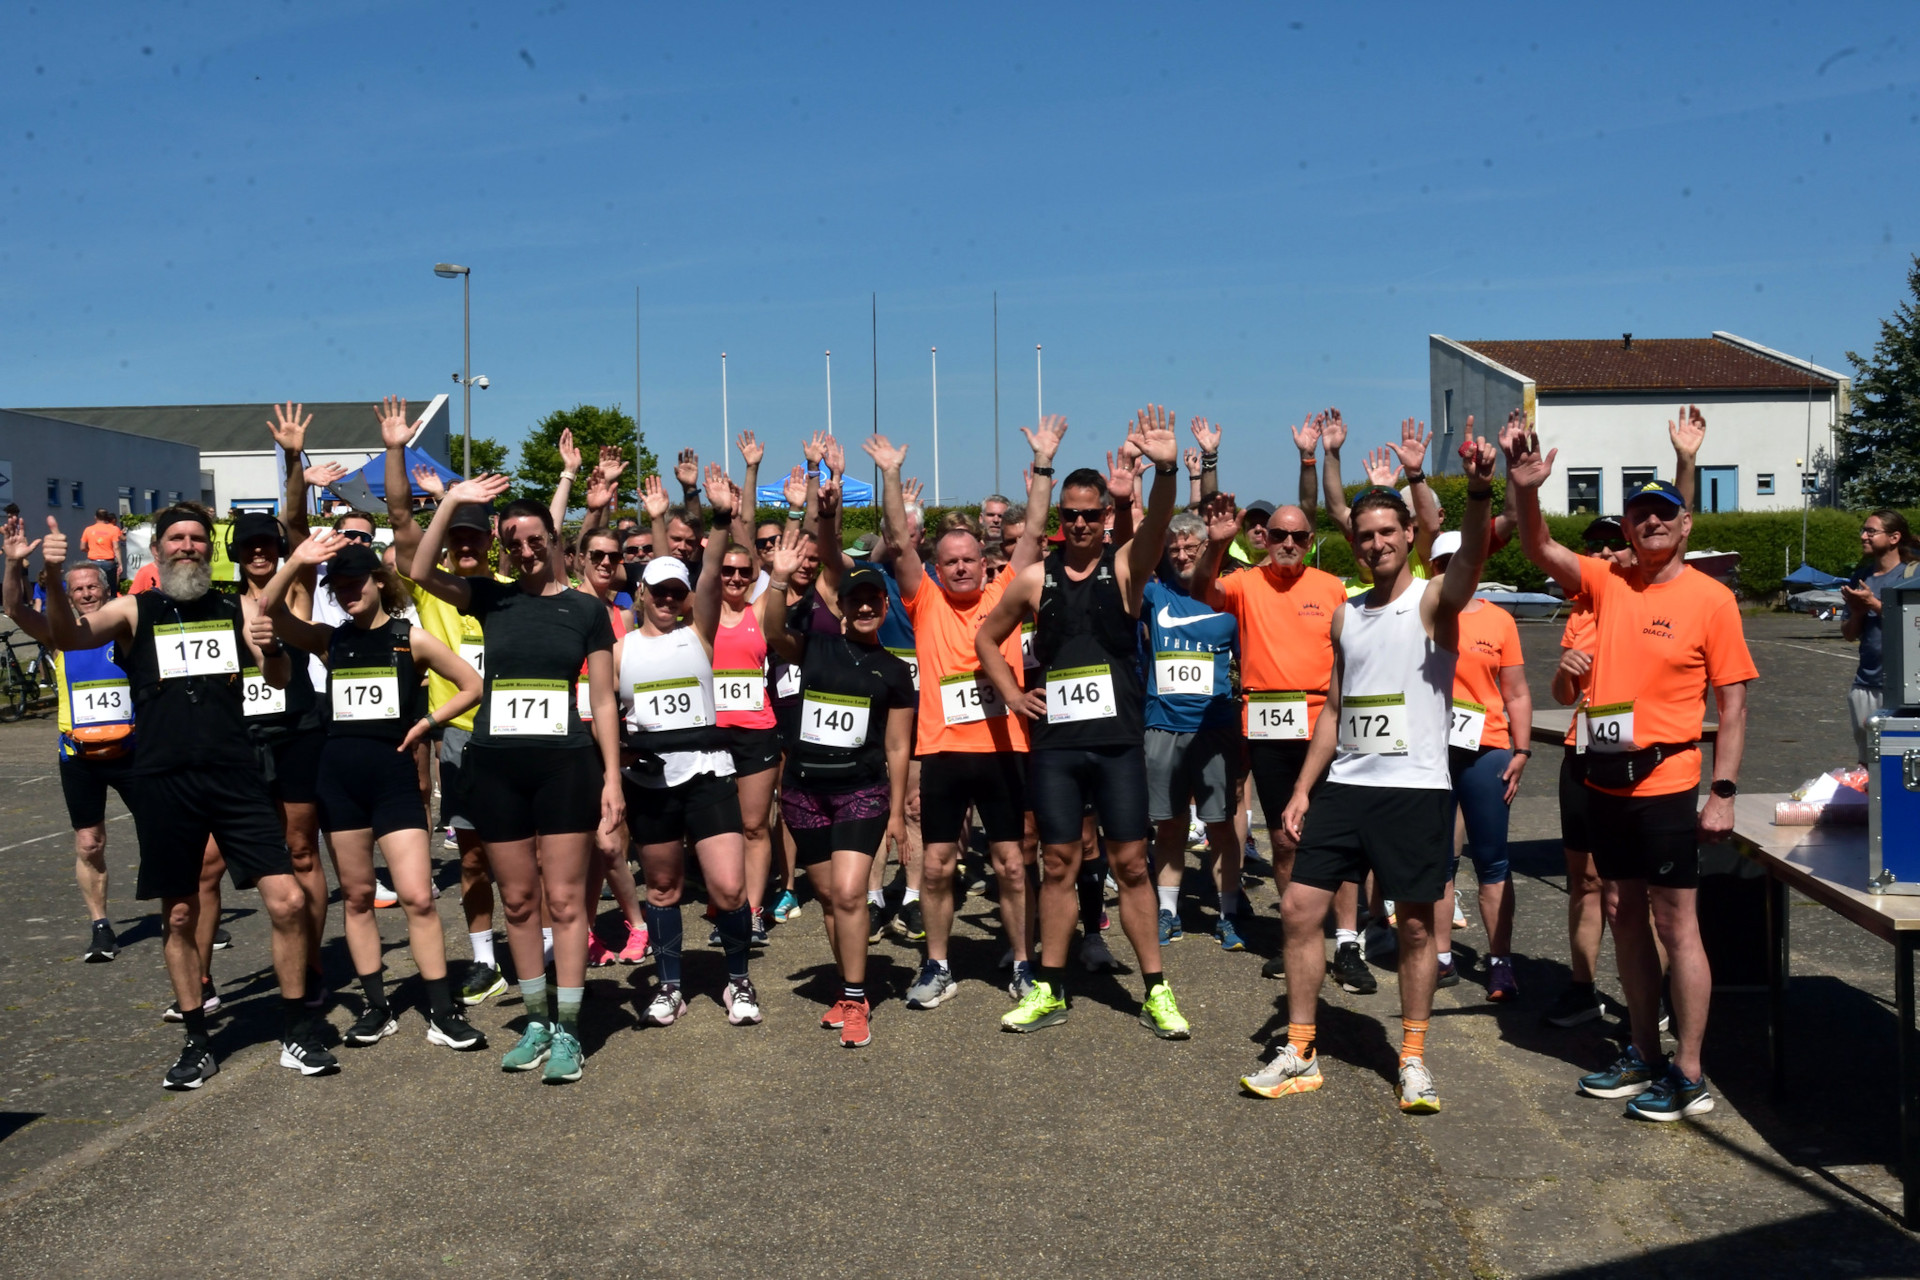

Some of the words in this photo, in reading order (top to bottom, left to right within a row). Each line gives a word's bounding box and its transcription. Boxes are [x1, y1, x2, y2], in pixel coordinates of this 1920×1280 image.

[175, 639, 220, 660] 178
[1167, 666, 1201, 682] 160
[86, 692, 122, 710] 143
[344, 686, 383, 705] 179
[720, 683, 751, 699] 161
[956, 685, 996, 708] 153
[1058, 682, 1100, 706] 146
[508, 698, 548, 718] 171
[649, 693, 690, 716] 139
[812, 708, 854, 732] 140
[1259, 708, 1294, 726] 154
[1349, 714, 1390, 737] 172
